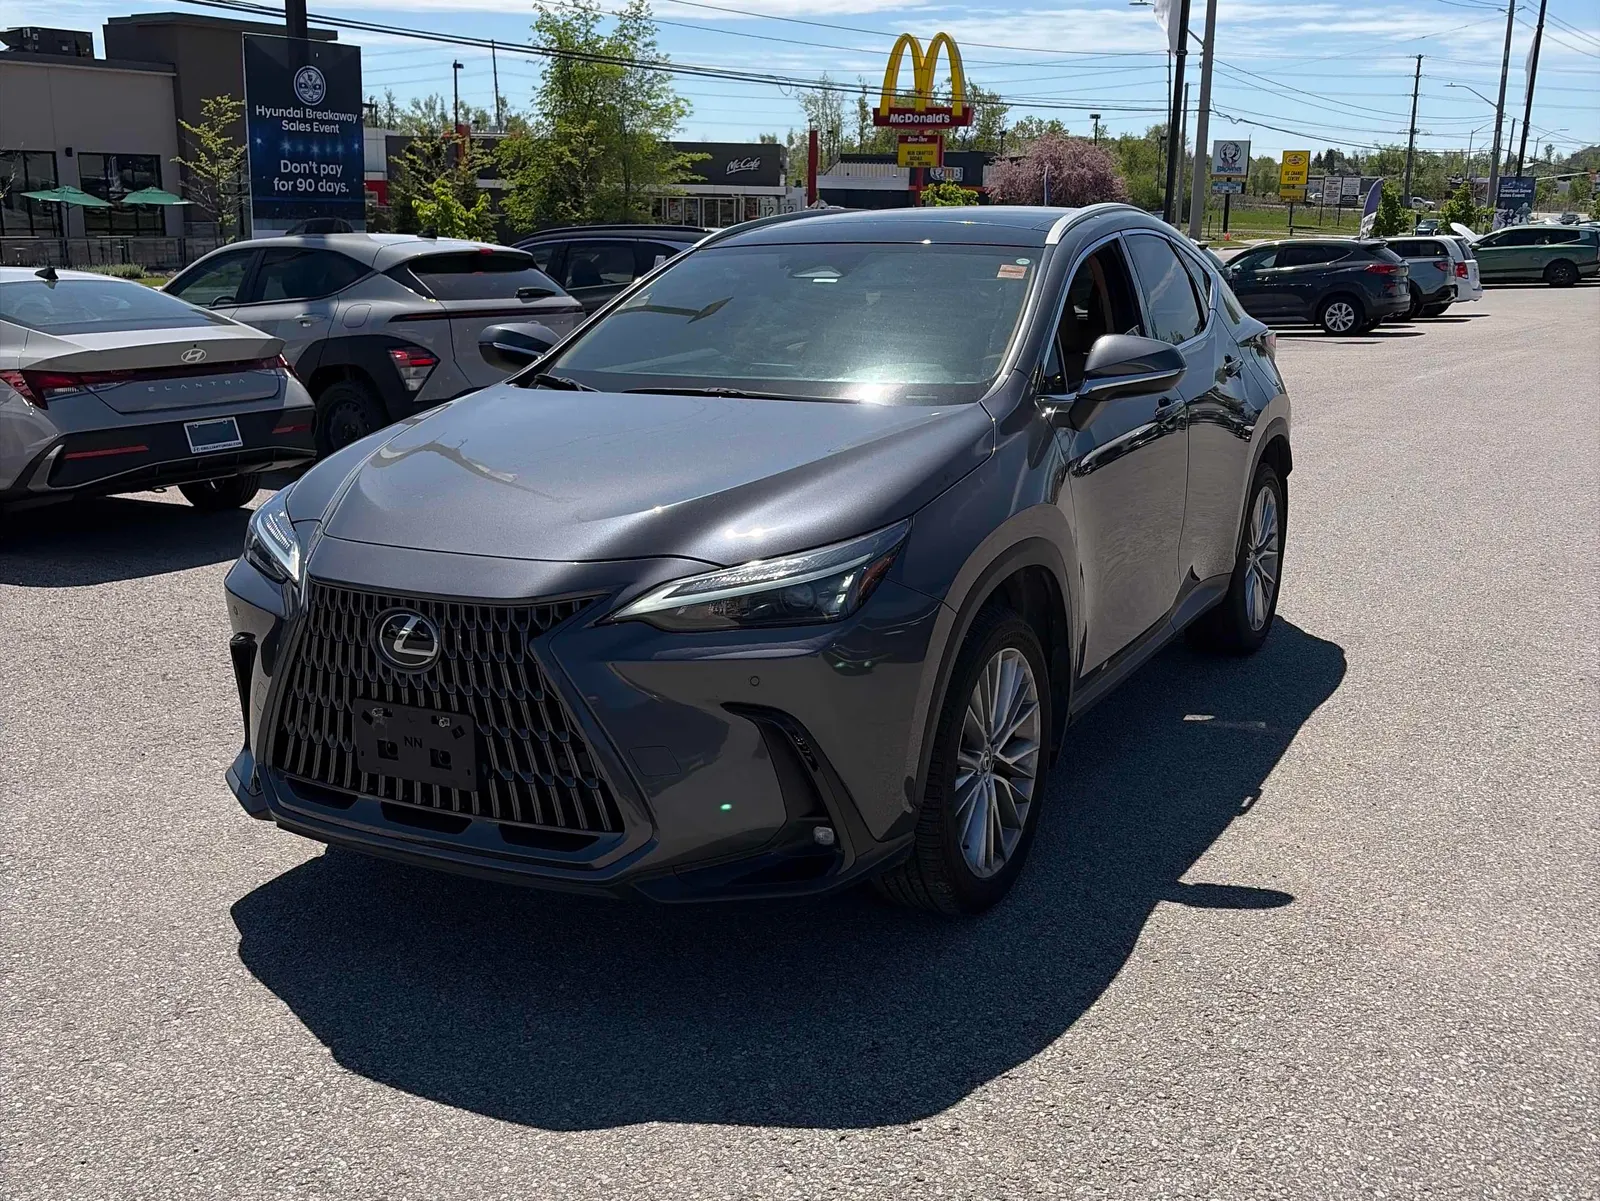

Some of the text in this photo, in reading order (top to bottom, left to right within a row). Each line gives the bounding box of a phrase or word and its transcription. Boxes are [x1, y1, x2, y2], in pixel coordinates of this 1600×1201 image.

[255, 105, 357, 124] Hyundai Breakaway
[889, 113, 950, 123] McDonald's
[281, 120, 339, 134] Sales Event
[280, 159, 343, 177] Don't pay
[273, 177, 349, 195] for 90 days.
[764, 206, 774, 217] 12
[148, 378, 245, 392] ELANTRA
